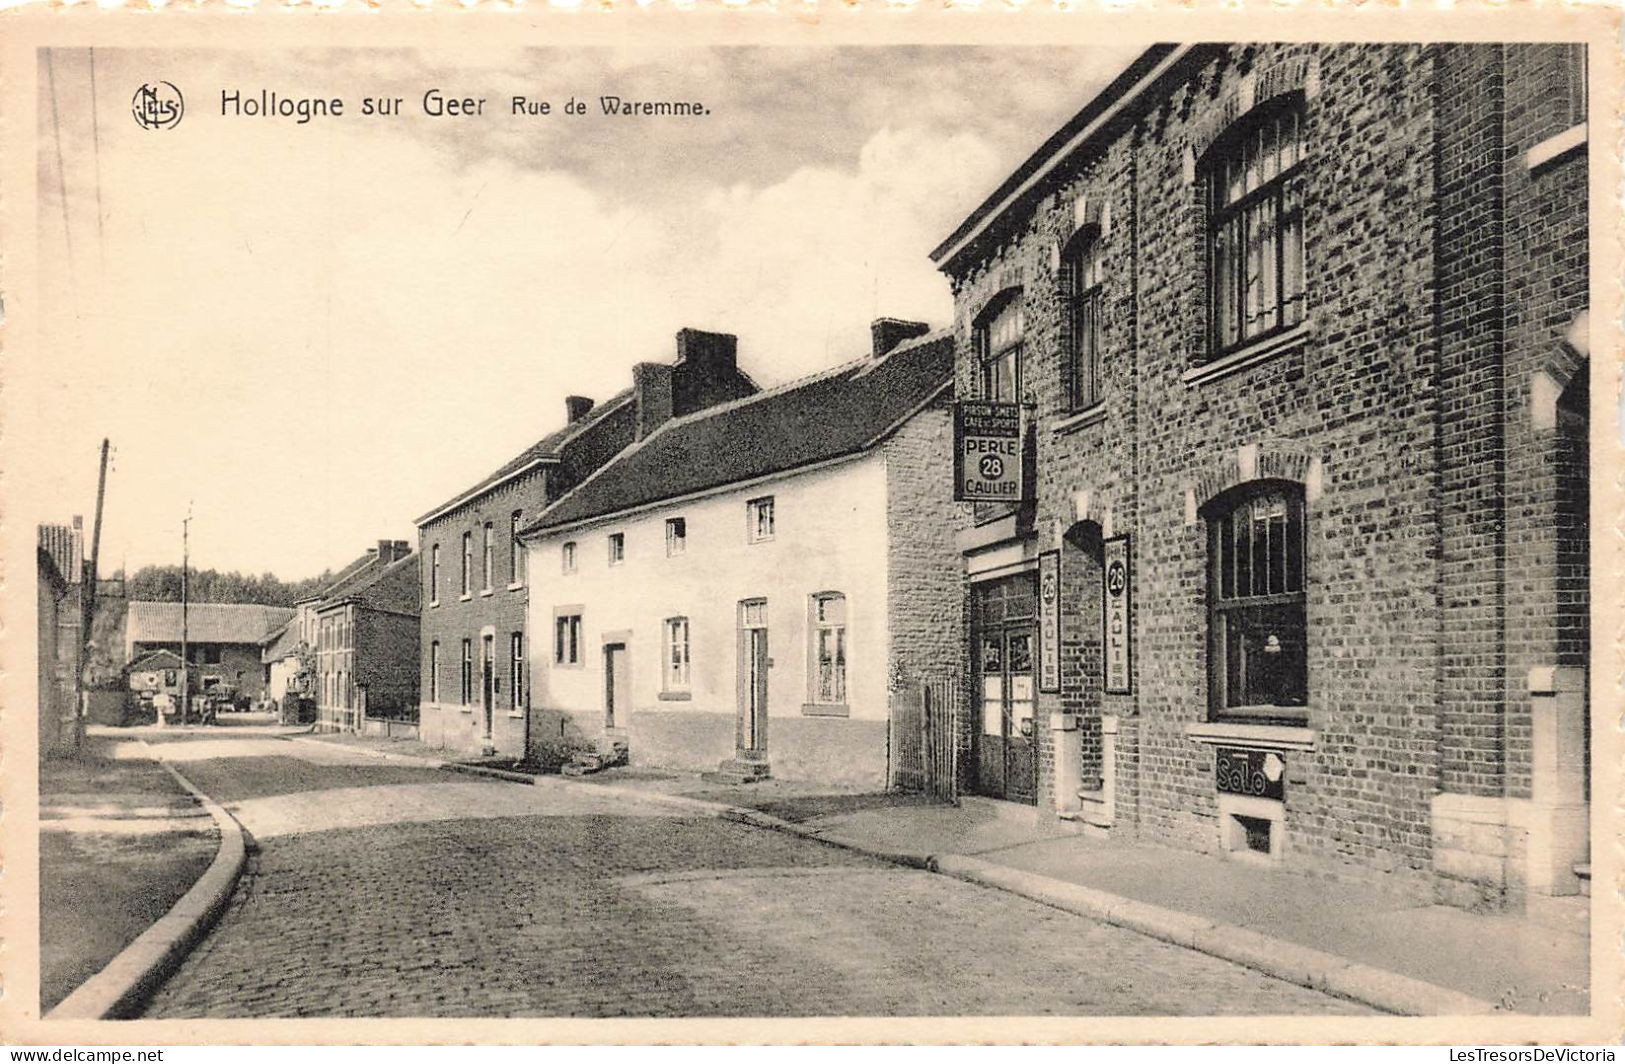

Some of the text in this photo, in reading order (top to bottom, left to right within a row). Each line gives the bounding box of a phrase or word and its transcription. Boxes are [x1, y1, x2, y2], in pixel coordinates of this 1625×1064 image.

[966, 439, 1017, 457] PERLE
[982, 458, 1003, 476] 28
[965, 479, 1017, 494] CAULIER
[1043, 577, 1055, 599] 28
[1110, 567, 1124, 590] 28
[1217, 757, 1266, 796] Solo
